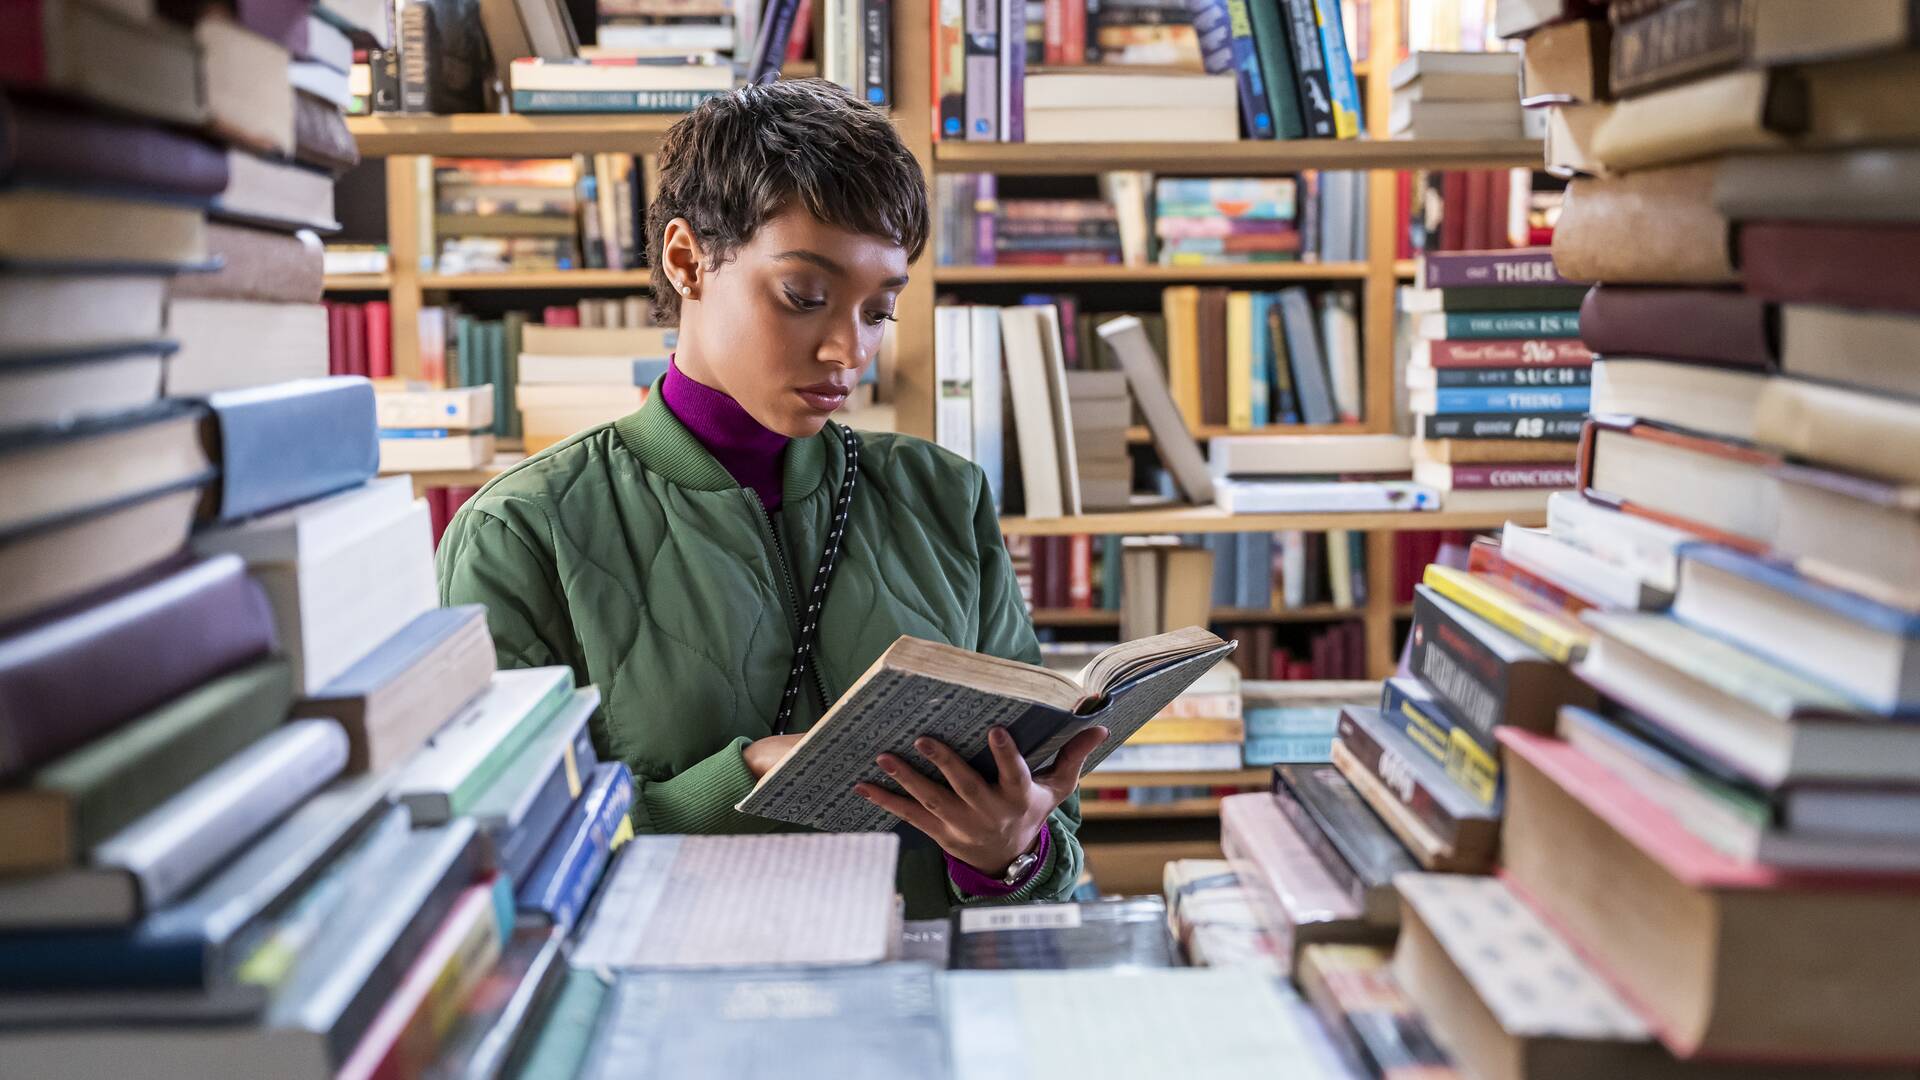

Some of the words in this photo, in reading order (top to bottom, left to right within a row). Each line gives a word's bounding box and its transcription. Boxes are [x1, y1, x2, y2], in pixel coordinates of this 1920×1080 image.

[1494, 262, 1556, 282] THERE
[1540, 316, 1562, 333] IS
[1522, 340, 1556, 362] No
[1514, 368, 1574, 384] SUCH
[1508, 392, 1563, 409] THING
[1514, 417, 1545, 438] AS
[1489, 469, 1577, 486] COINCIDEN
